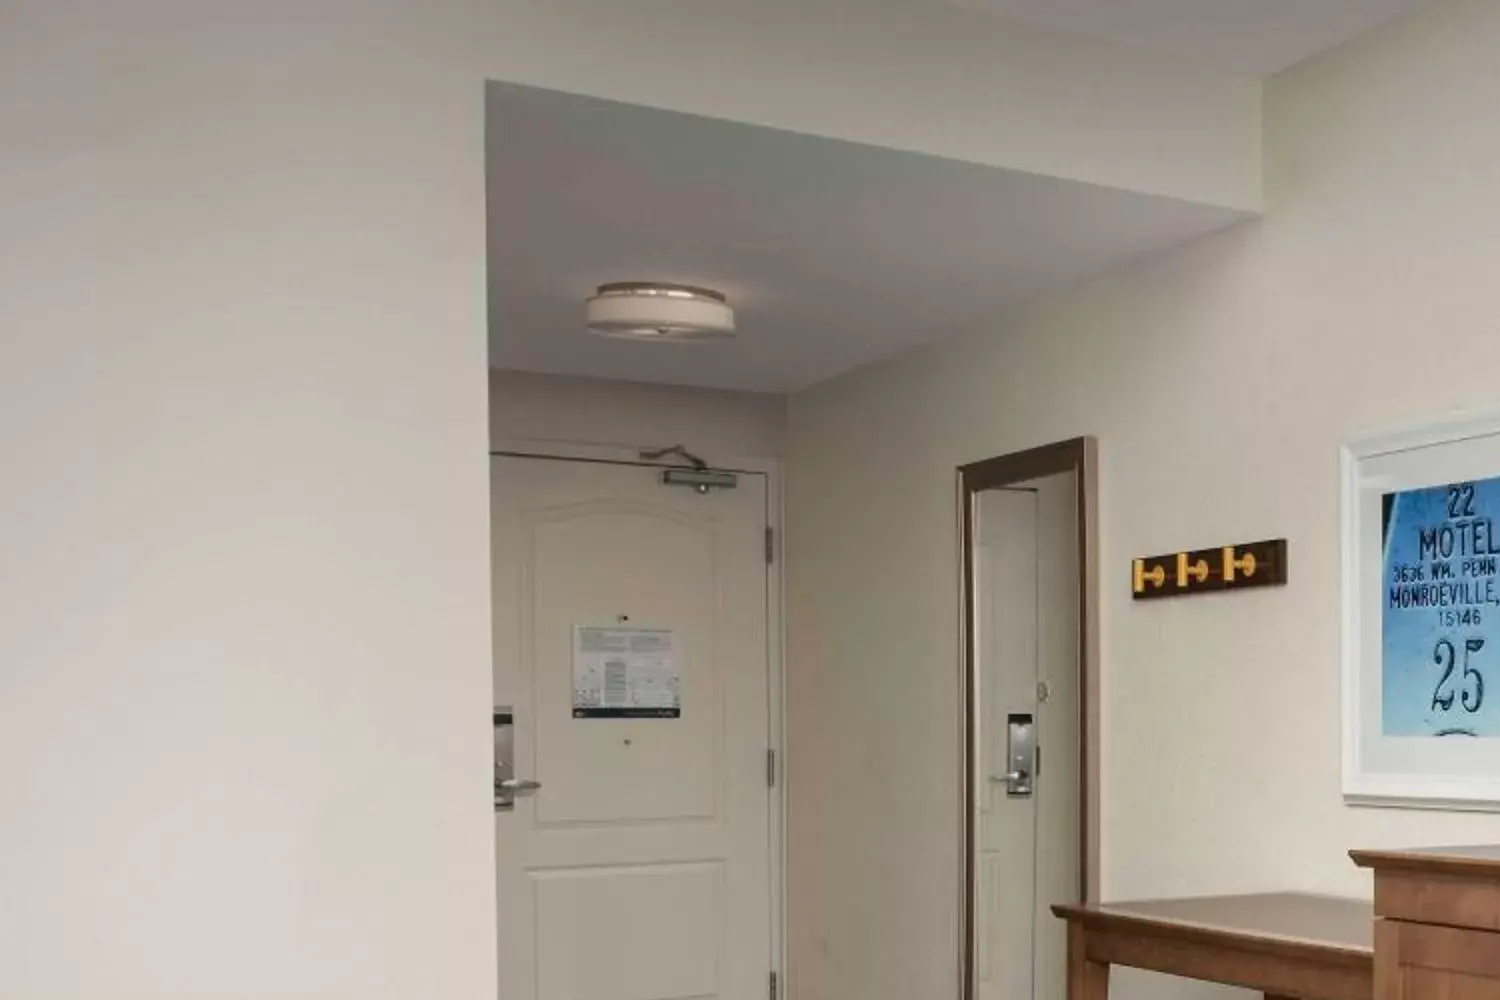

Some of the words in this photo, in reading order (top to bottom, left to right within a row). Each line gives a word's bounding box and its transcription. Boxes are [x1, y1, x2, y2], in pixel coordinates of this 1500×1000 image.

[1448, 484, 1475, 518] 22
[1393, 563, 1424, 583] 3636
[1462, 557, 1496, 578] PENN
[1389, 580, 1500, 609] MONROEVILLE,
[1439, 609, 1481, 627] 15146
[1431, 638, 1485, 714] 25
